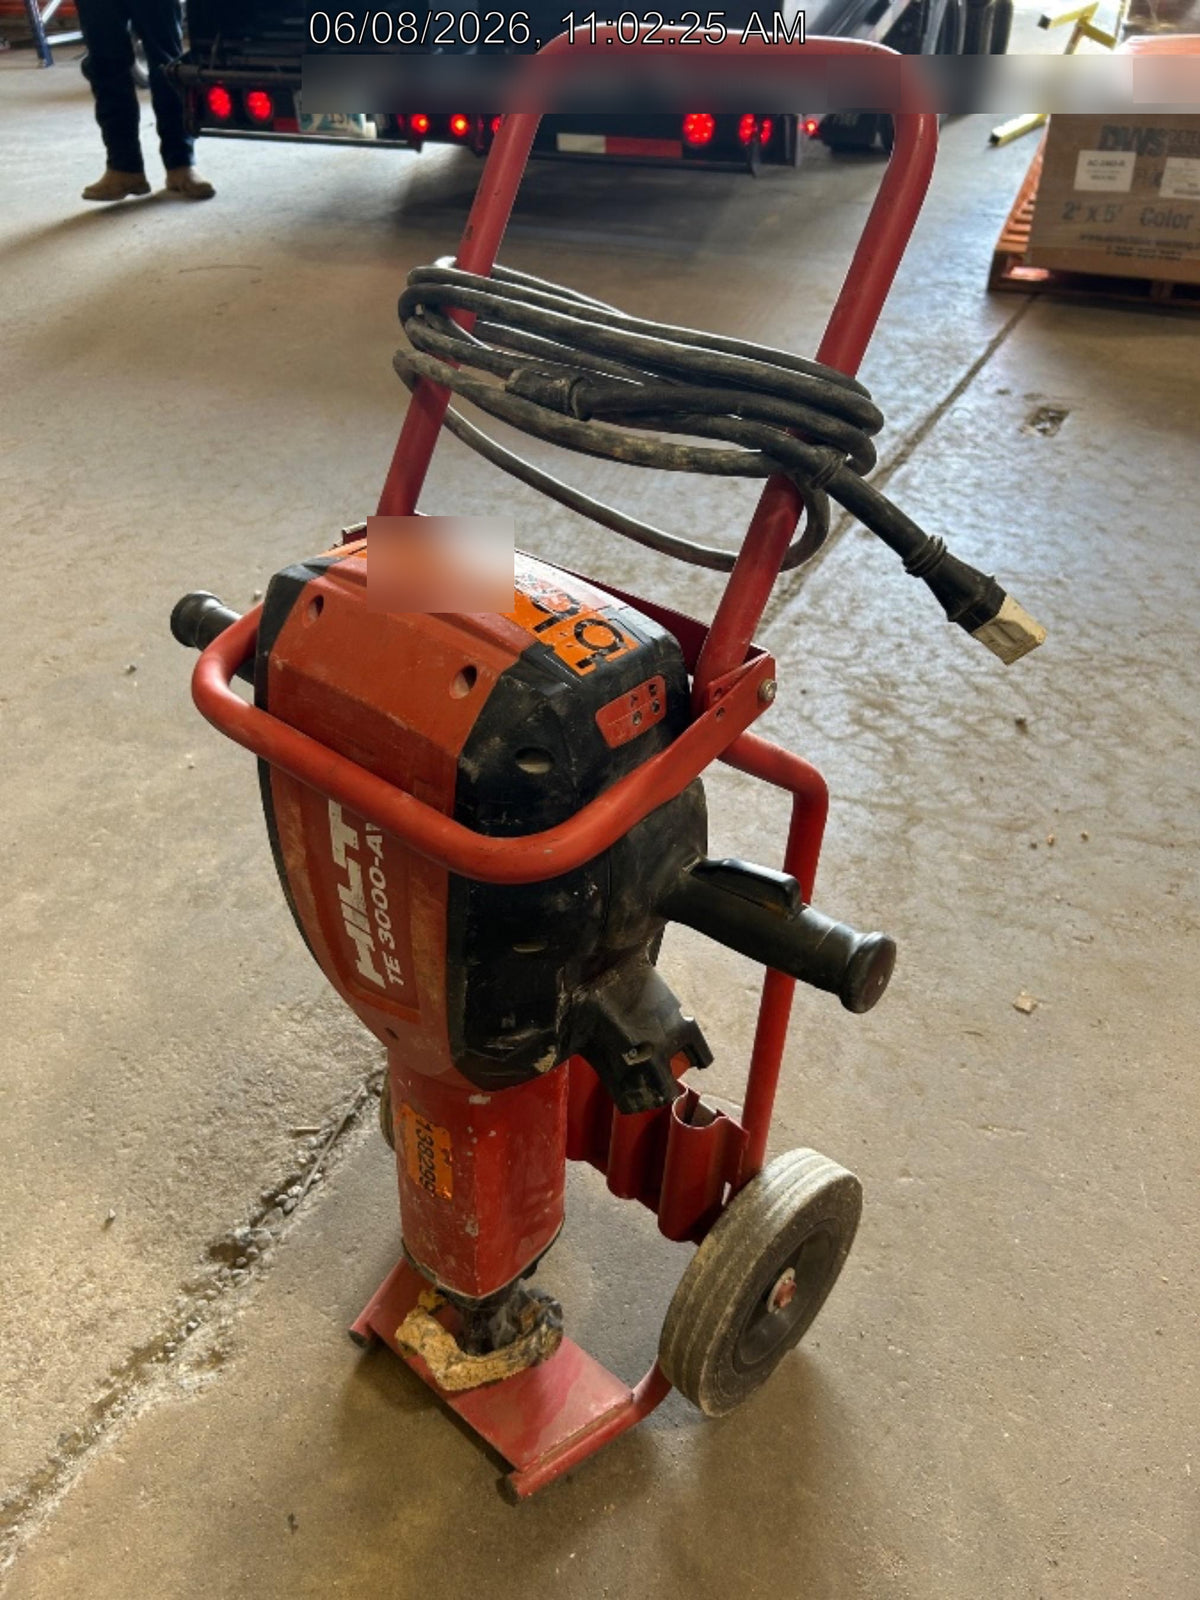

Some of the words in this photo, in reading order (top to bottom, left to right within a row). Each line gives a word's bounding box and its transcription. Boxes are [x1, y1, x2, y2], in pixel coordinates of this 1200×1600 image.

[1140, 207, 1193, 229] Color
[328, 799, 386, 989] HILT
[382, 951, 404, 986] TE
